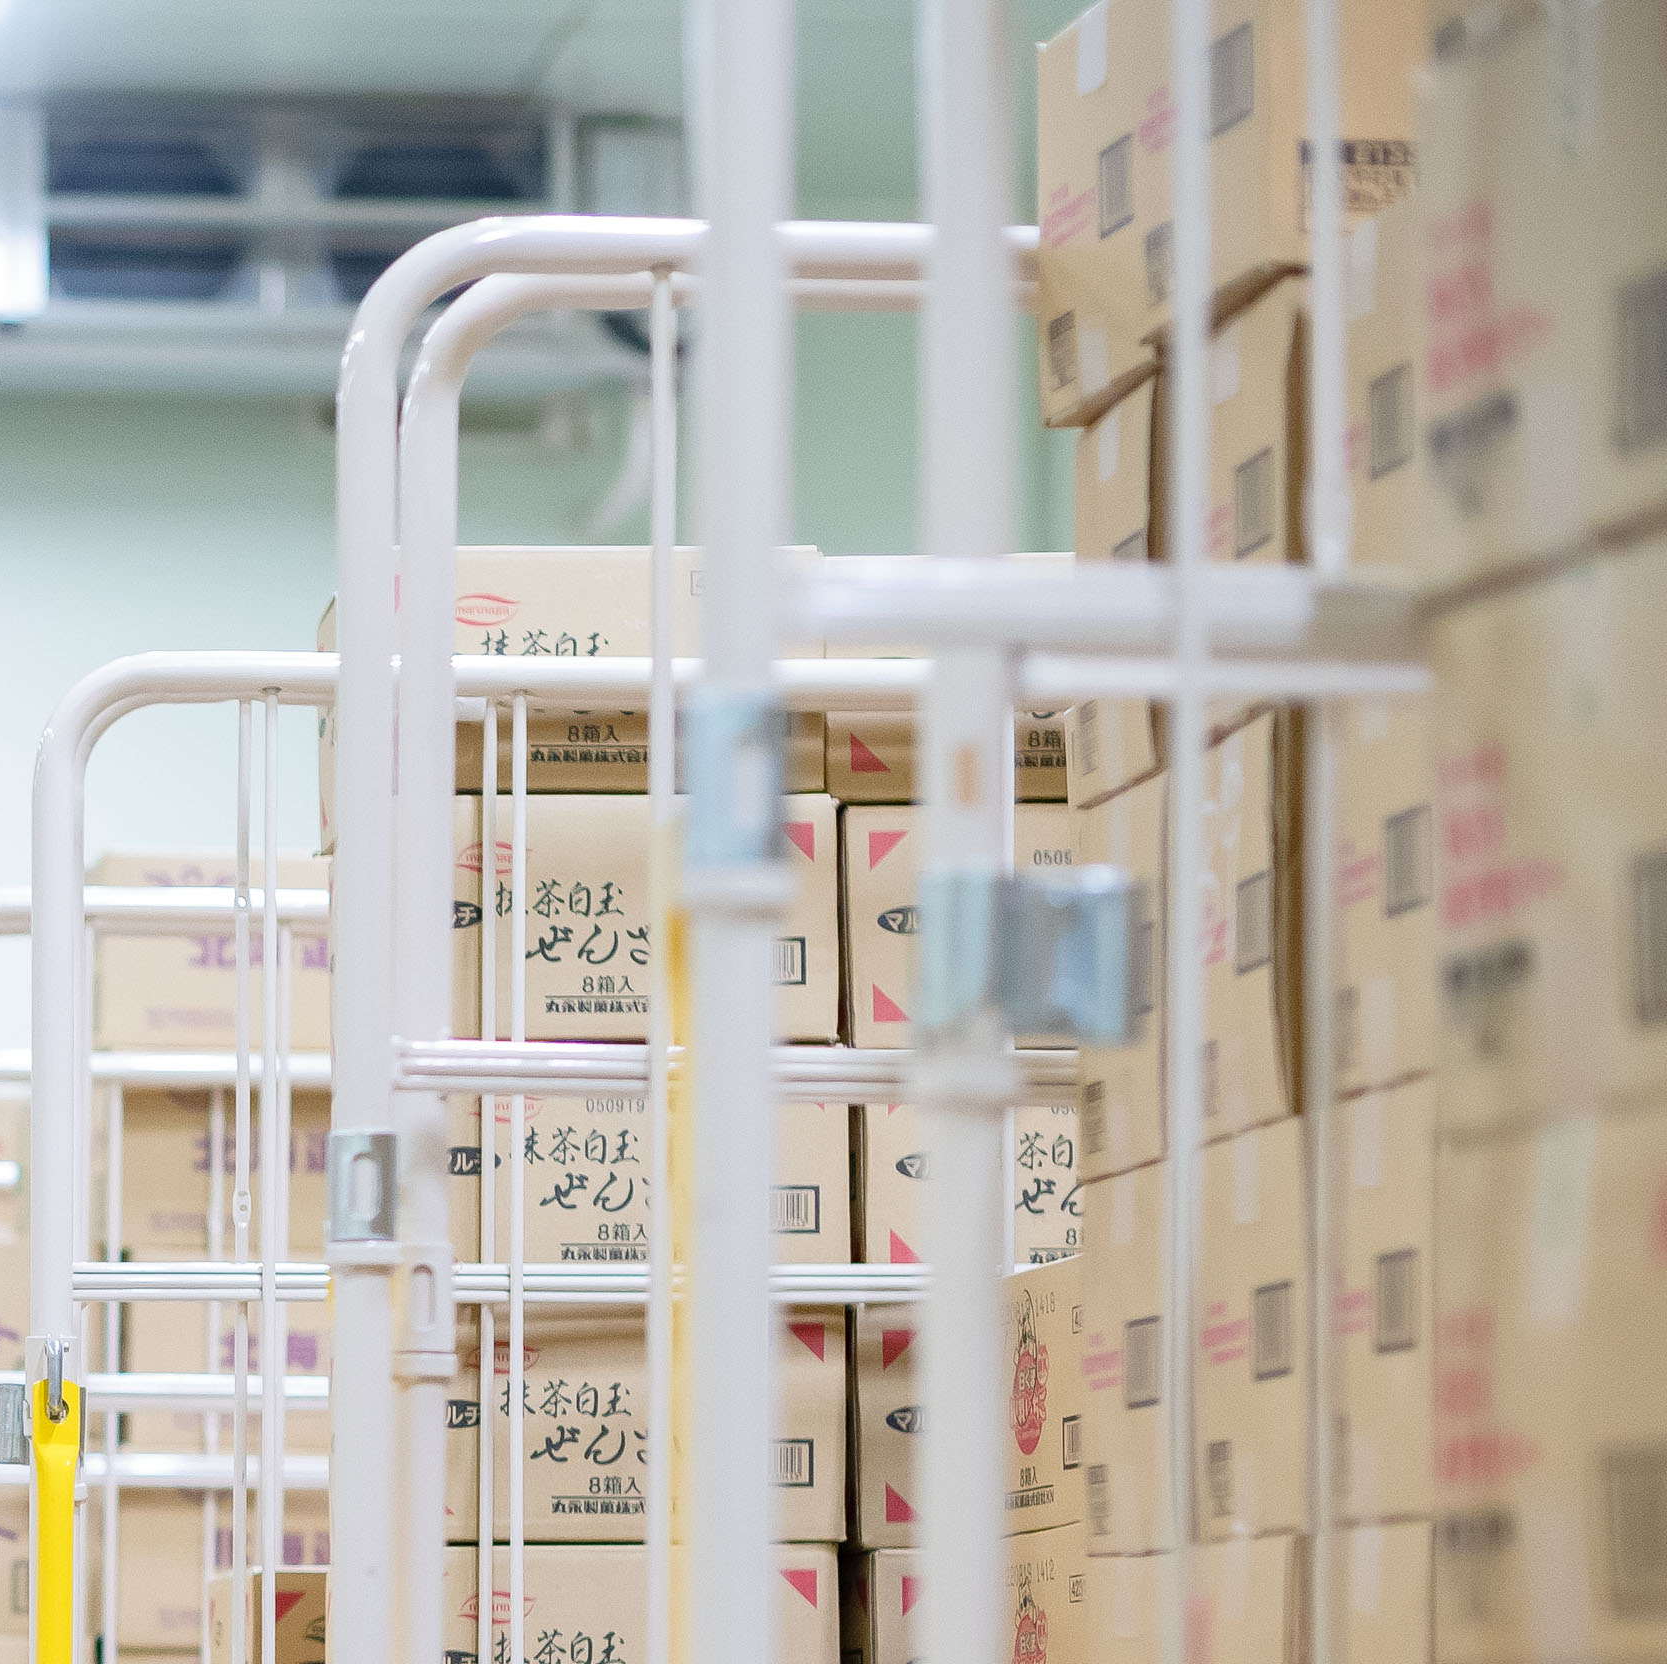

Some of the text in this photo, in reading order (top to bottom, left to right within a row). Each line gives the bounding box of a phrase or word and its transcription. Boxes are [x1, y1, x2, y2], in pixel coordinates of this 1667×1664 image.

[568, 725, 619, 743] 8箱入
[582, 976, 634, 993] 8箱入
[598, 1223, 647, 1241] 8箱入
[589, 1477, 641, 1494] 8箱入
